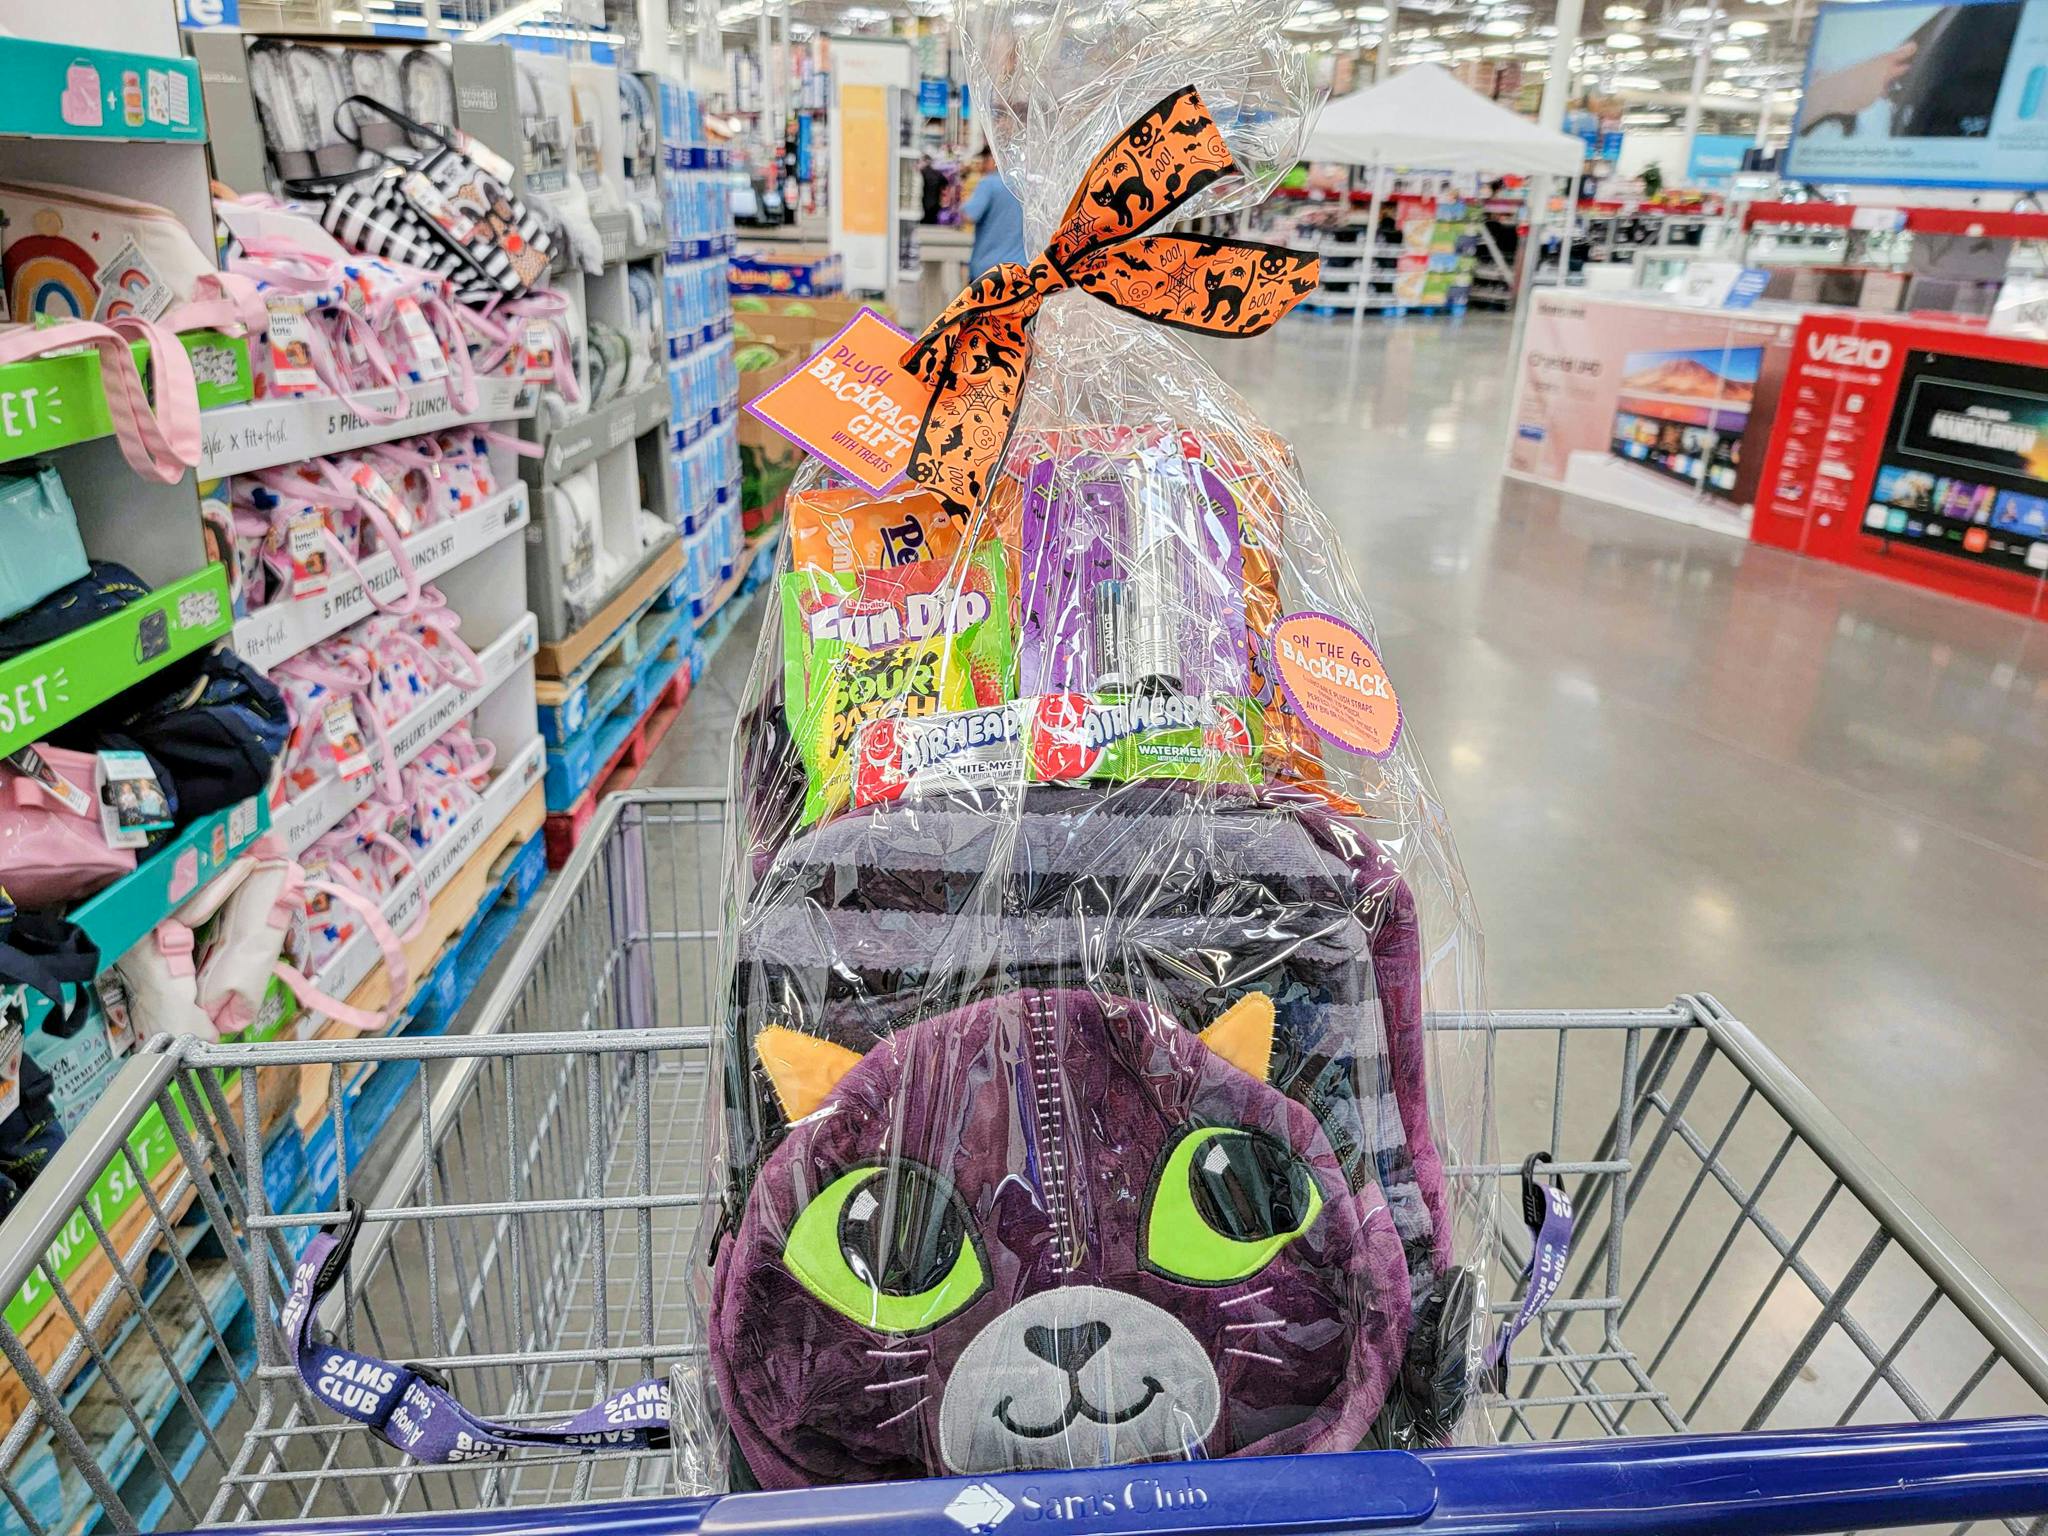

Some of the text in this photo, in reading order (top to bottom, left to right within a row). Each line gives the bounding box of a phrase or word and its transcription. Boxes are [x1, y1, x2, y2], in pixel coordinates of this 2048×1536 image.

[1151, 147, 1175, 181] BOO!
[1160, 244, 1182, 267] BOO!
[1249, 289, 1276, 311] BOO!
[833, 345, 893, 387] PLUSH
[1807, 332, 1892, 369] VIZIO
[416, 397, 448, 417] LUNCH
[809, 357, 921, 439] BACKPAC
[329, 416, 335, 434] 5
[340, 411, 370, 433] PIEC
[847, 414, 912, 459] GIFT
[832, 431, 893, 473] WITH TREATS
[951, 466, 964, 495] BOO!
[324, 601, 331, 619] 5
[367, 565, 404, 593] DELUX
[411, 546, 438, 570] UNCH
[810, 591, 991, 653] Fun Dip
[1280, 638, 1390, 700] BACKPACK
[1293, 634, 1371, 668] ON THE GO
[0, 674, 48, 733] SET
[834, 663, 938, 714] SOUR
[902, 708, 1021, 773] AIRHEAD
[1521, 1276, 1548, 1326] Always
[322, 1355, 398, 1395] SAMS
[318, 1376, 380, 1415] CLUB
[604, 1383, 670, 1415] SAMS
[608, 1402, 670, 1424] CLUB
[388, 1405, 424, 1448] Always
[565, 1428, 636, 1444] SAMS
[1123, 1476, 1209, 1515] Club
